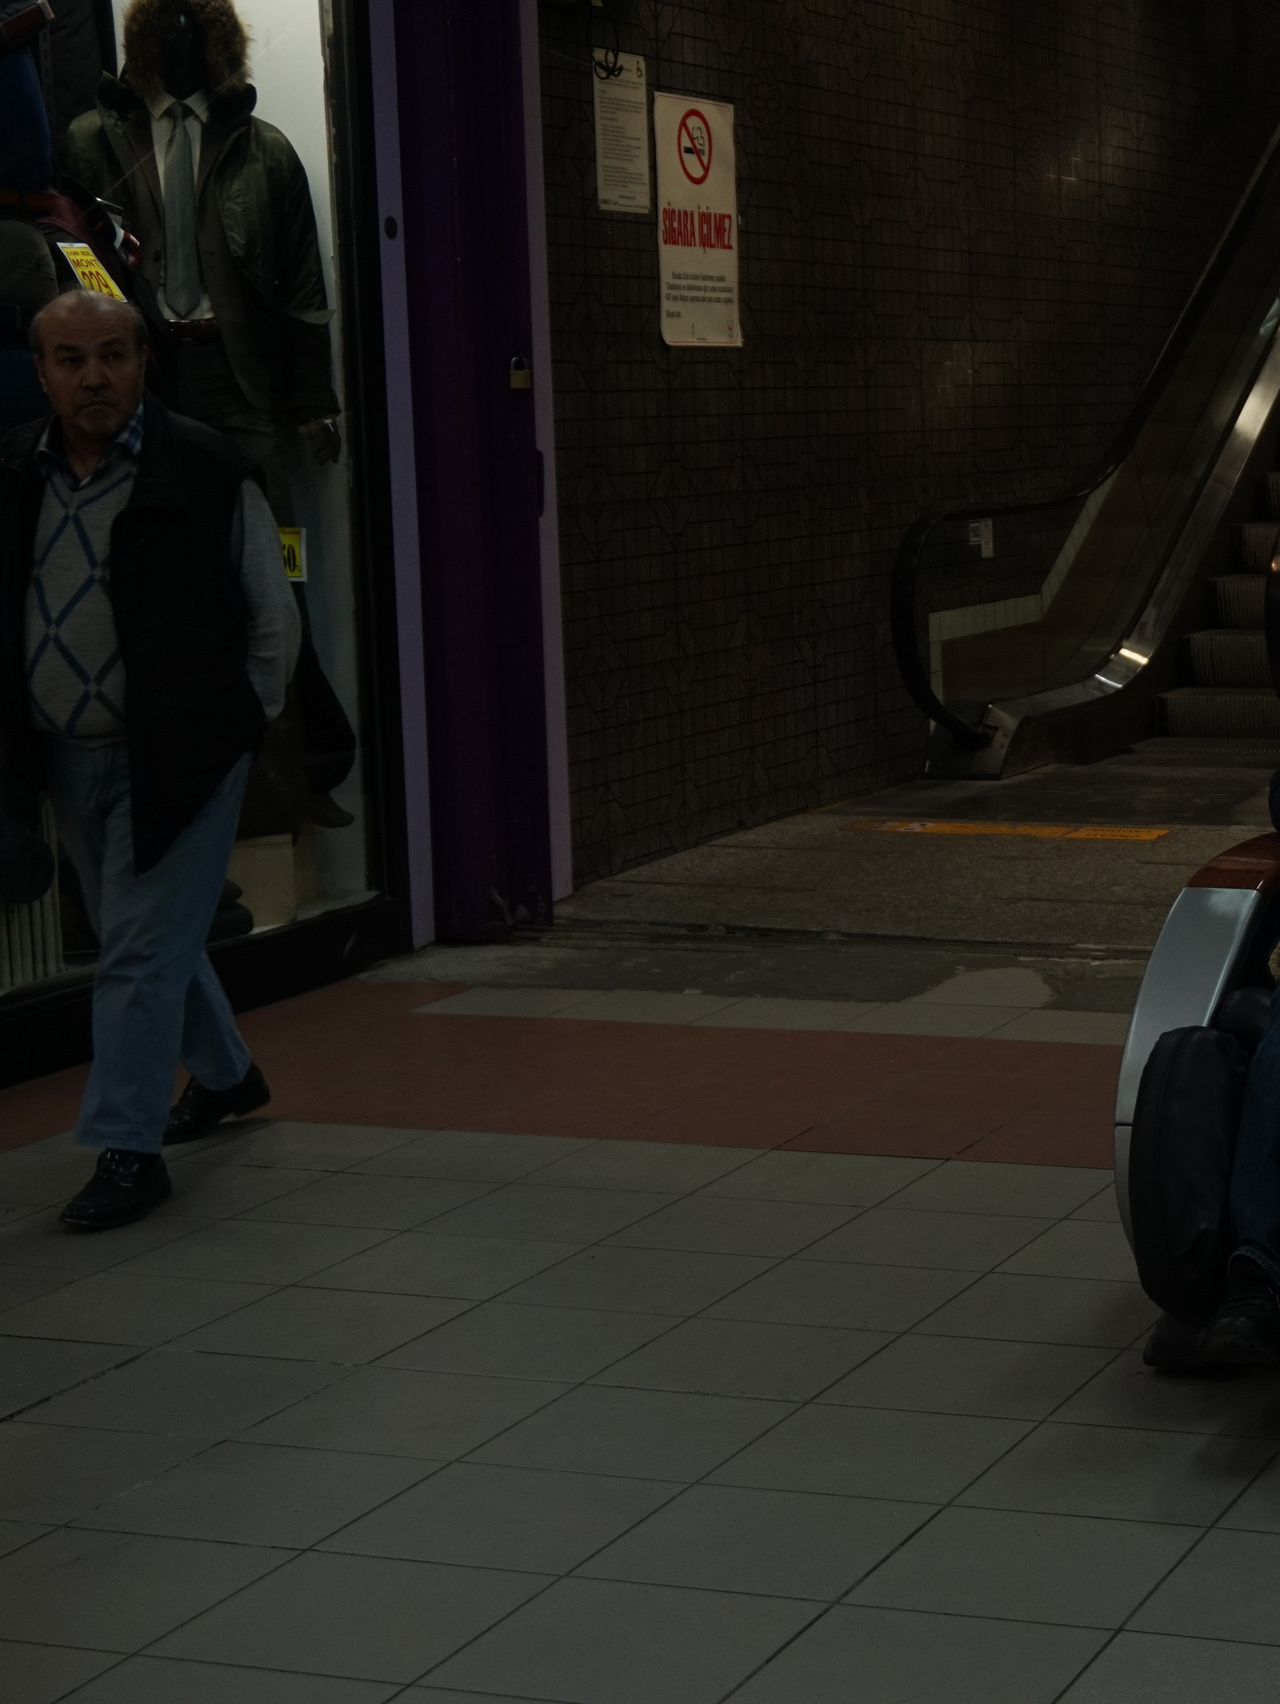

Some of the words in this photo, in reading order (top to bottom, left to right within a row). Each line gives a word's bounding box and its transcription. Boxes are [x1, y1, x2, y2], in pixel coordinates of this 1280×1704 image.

[662, 202, 697, 247] SİGARA
[698, 205, 733, 253] İÇİLMEZ
[72, 259, 100, 268] MONT
